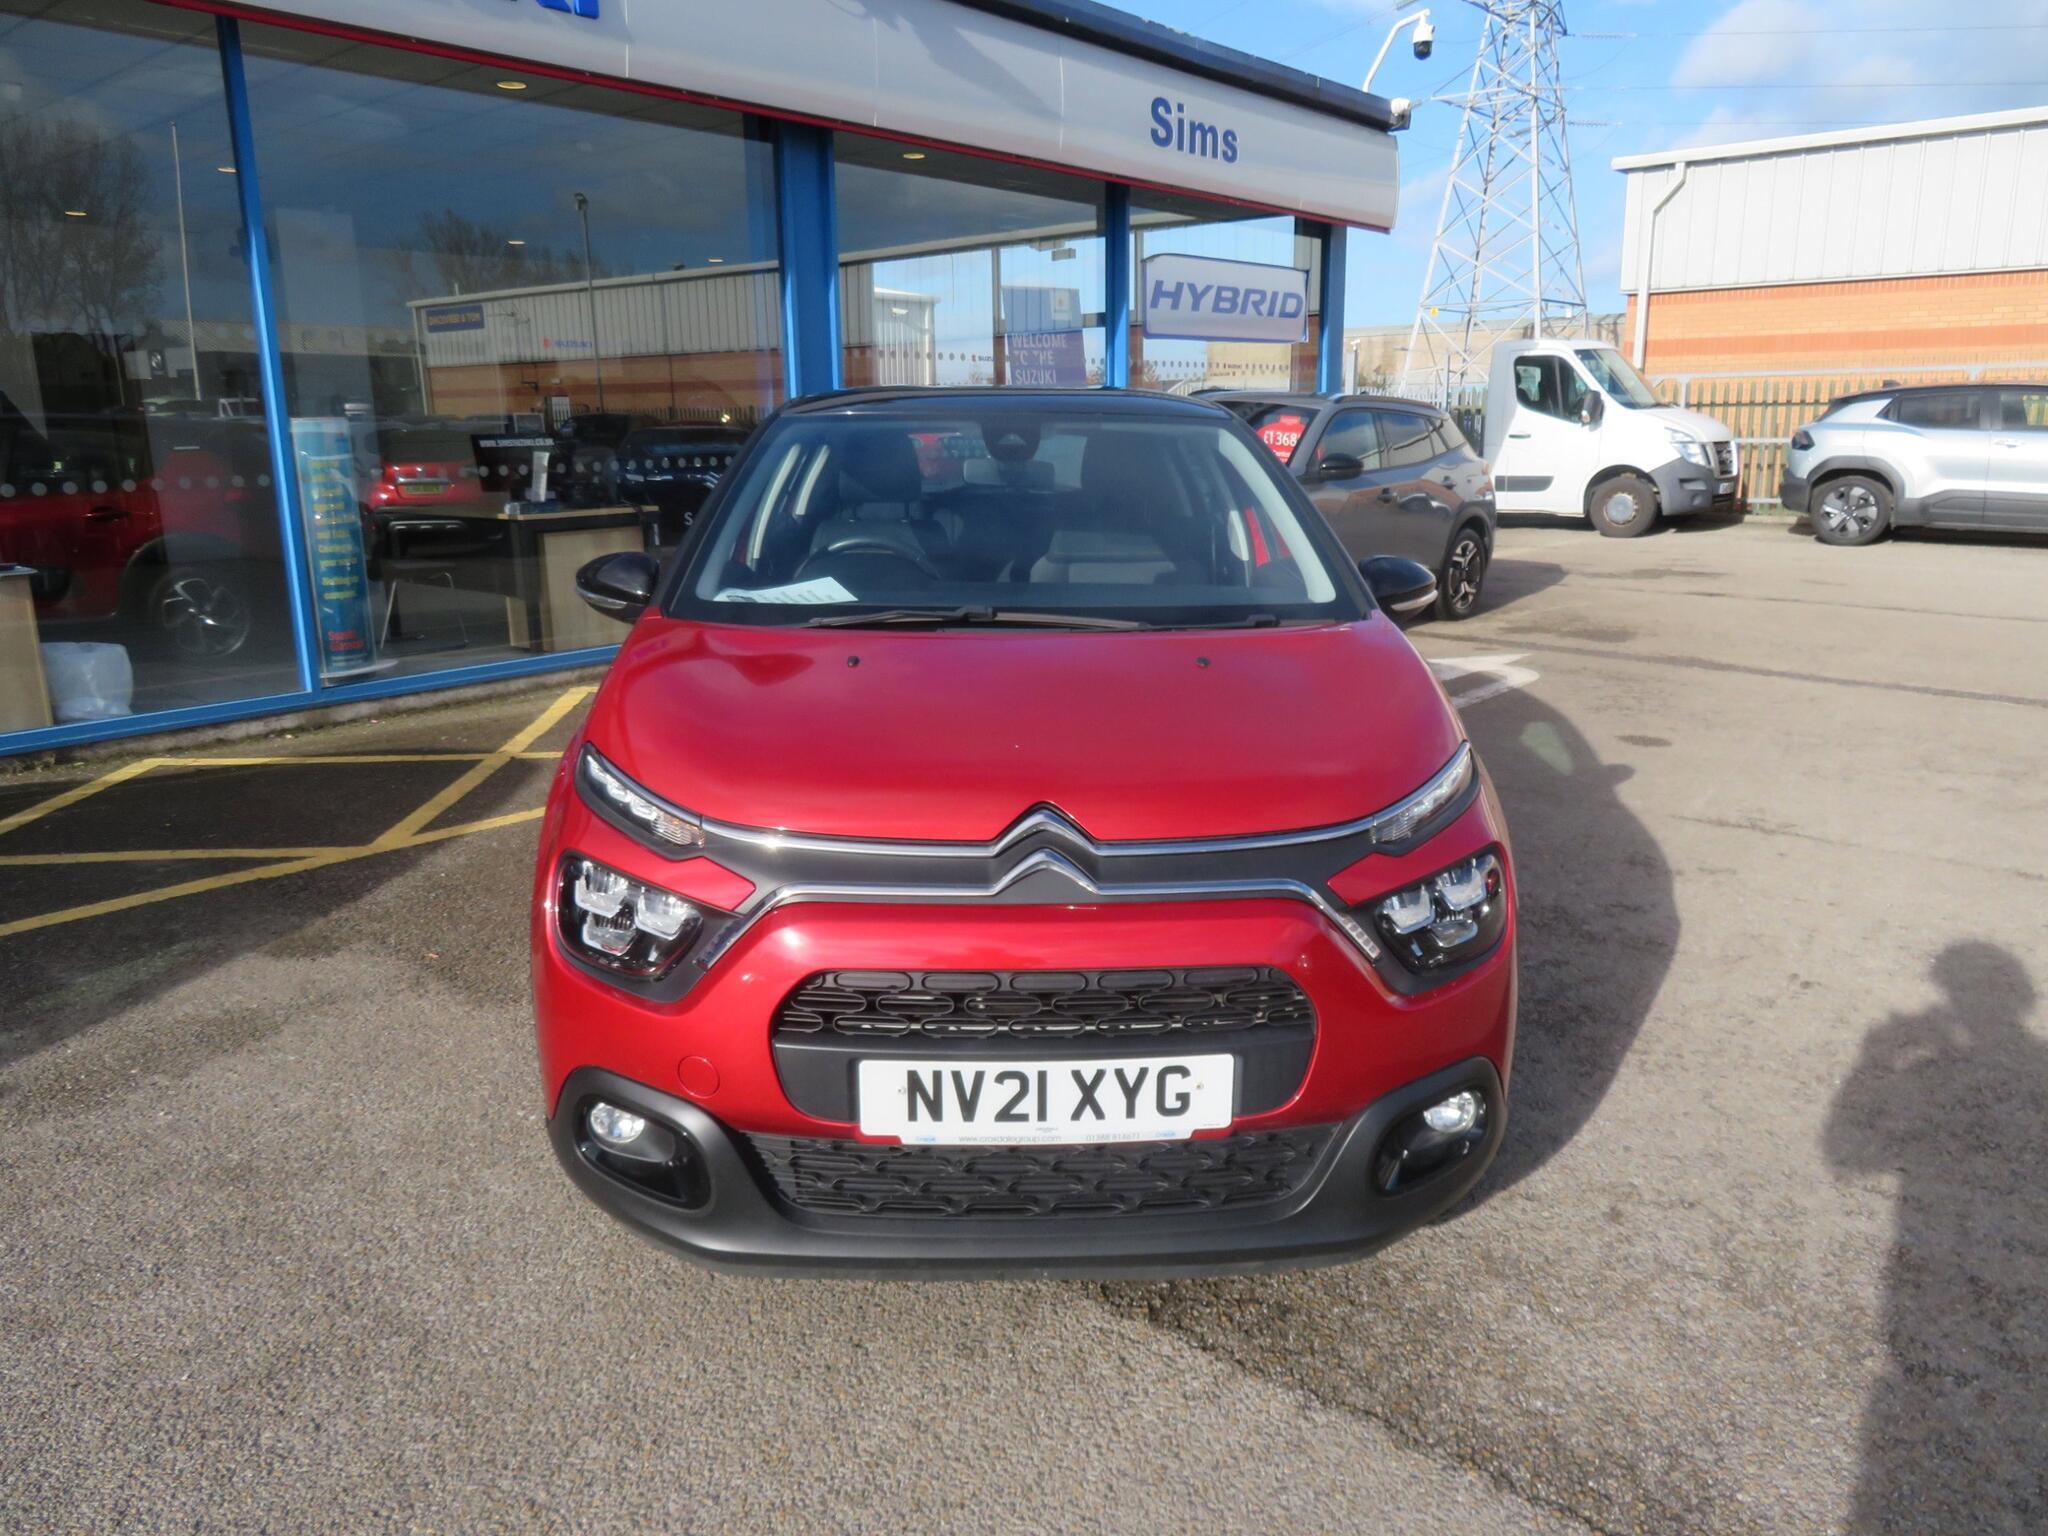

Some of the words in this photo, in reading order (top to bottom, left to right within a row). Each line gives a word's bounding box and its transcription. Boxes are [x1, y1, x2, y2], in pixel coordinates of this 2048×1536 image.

[1150, 96, 1239, 164] Sims
[1150, 279, 1304, 319] HYBRID
[1011, 334, 1068, 348] WELCOME
[1015, 369, 1057, 385] SUZUKI
[906, 1069, 1048, 1123] NV21
[1069, 1064, 1191, 1122] XYG
